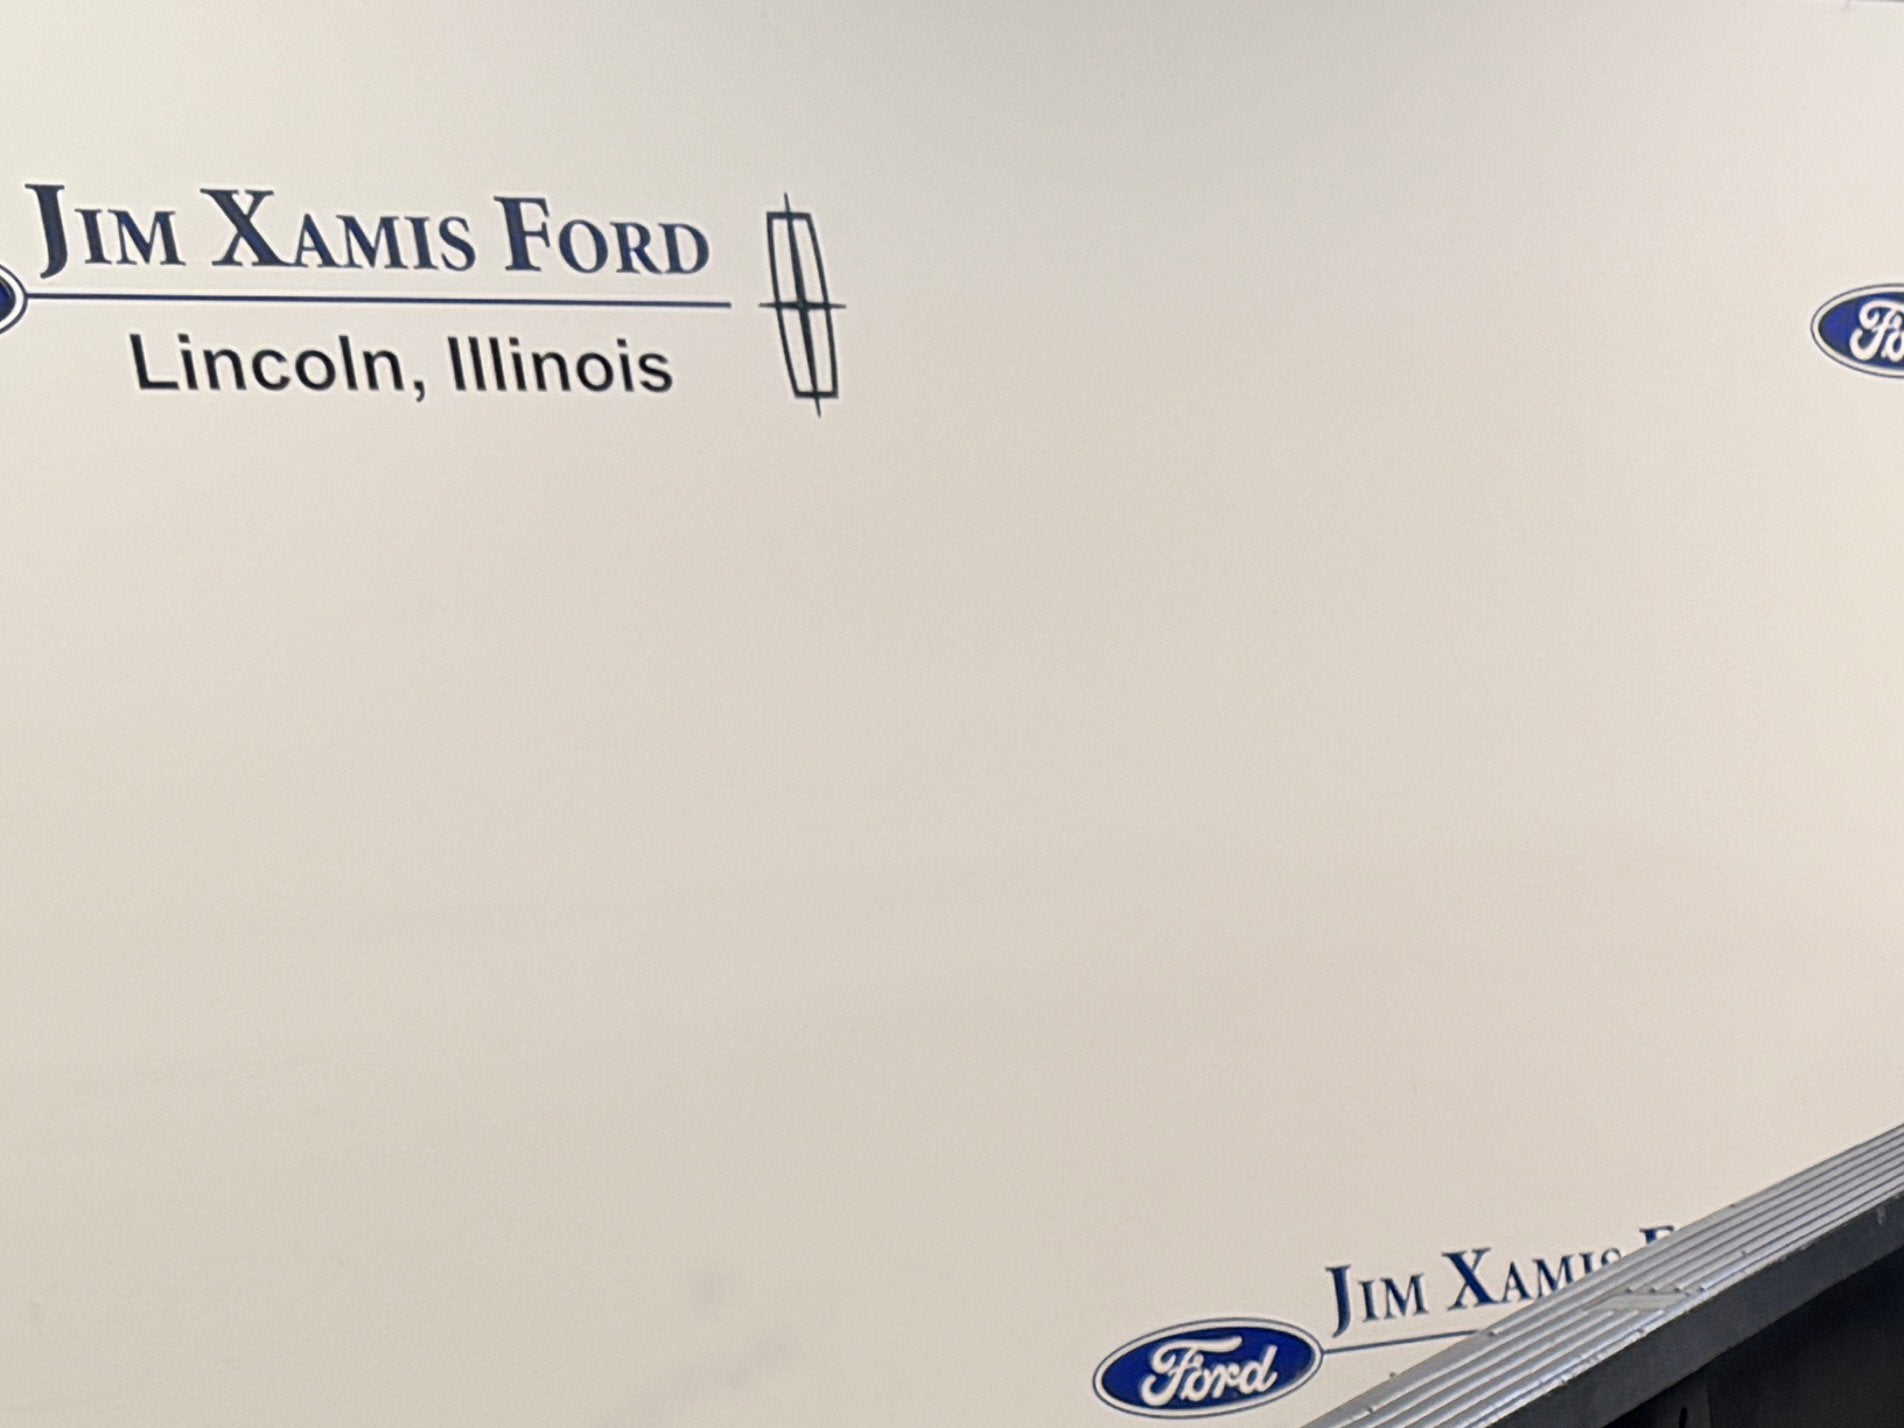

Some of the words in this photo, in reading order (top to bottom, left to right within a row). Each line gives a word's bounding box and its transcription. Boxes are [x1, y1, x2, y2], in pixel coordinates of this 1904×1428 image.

[25, 183, 186, 279] JIM
[200, 188, 476, 272] XAMIS
[493, 196, 710, 275] FORD
[129, 333, 425, 402] Lincoln,
[447, 335, 673, 393] Illinois
[1325, 1264, 1429, 1338] JIM
[1140, 1336, 1278, 1407] Ford
